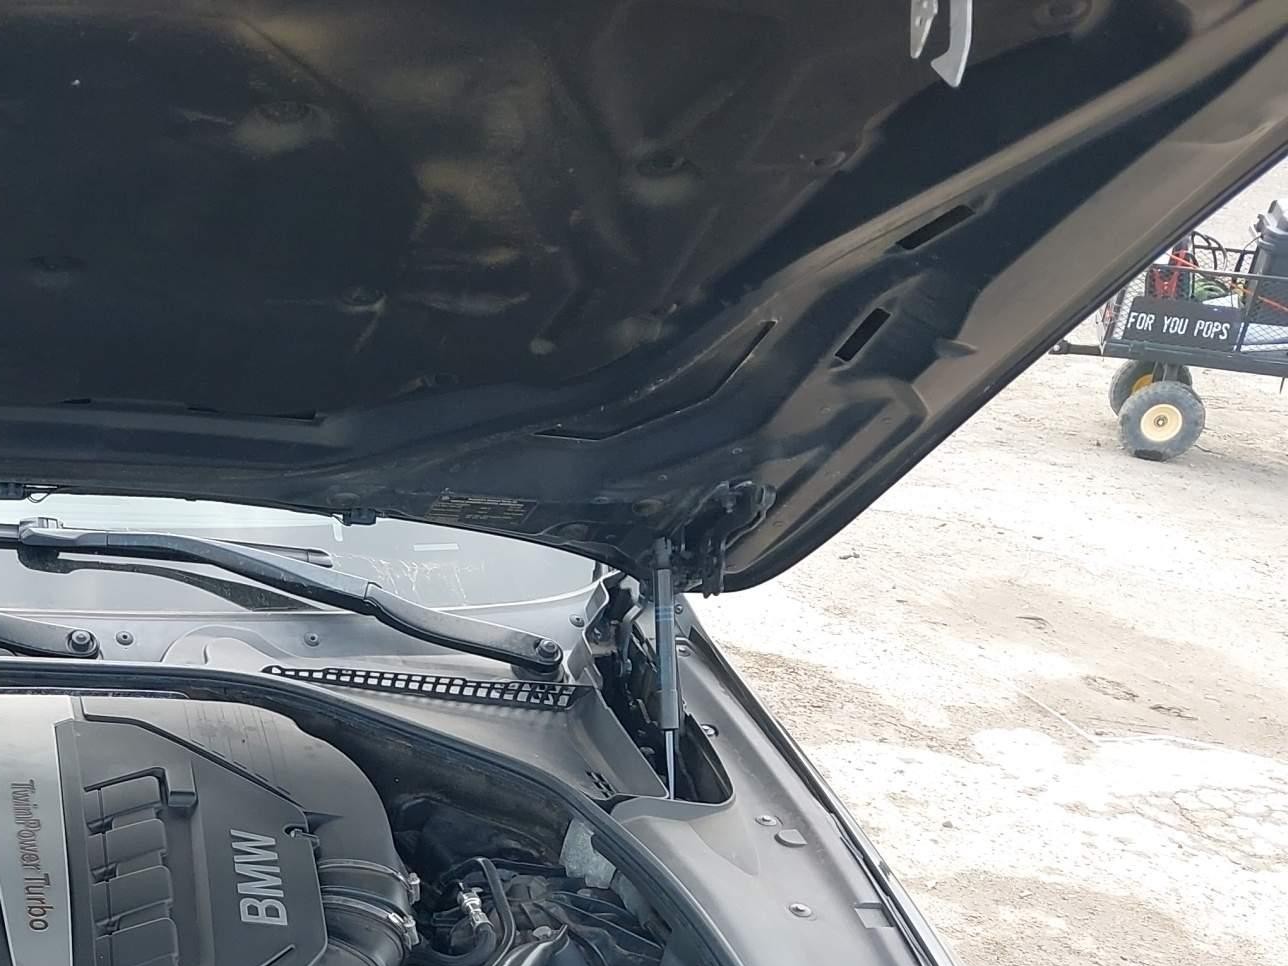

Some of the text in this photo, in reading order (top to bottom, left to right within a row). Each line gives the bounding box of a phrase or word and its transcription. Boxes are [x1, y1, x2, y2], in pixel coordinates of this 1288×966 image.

[1127, 312, 1231, 340] FOR YOU POPS
[10, 779, 54, 932] TwinPower Turbo
[230, 829, 288, 926] BMW
